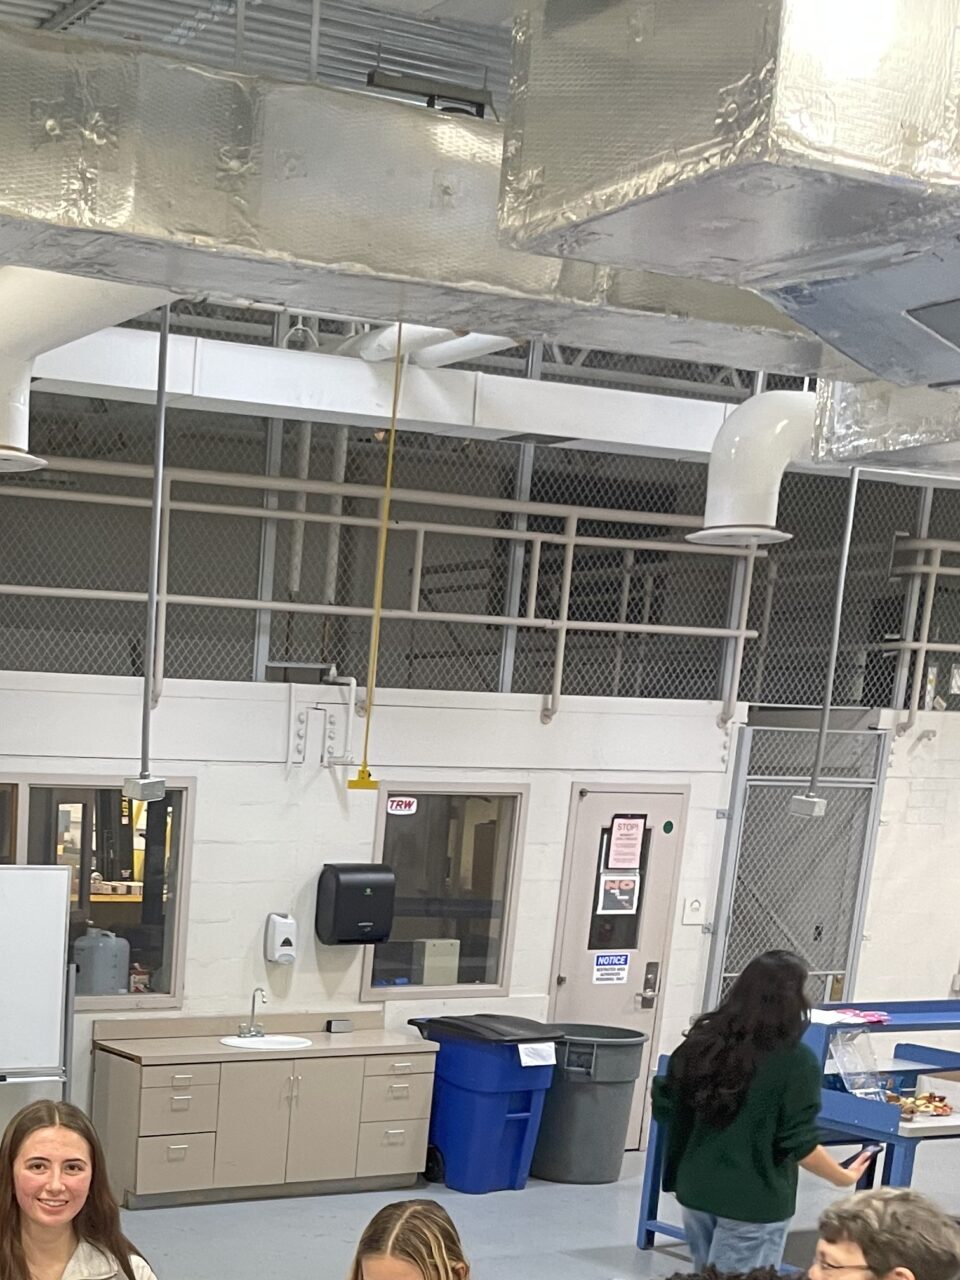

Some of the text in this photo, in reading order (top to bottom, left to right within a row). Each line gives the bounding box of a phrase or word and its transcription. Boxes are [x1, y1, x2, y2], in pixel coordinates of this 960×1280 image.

[390, 800, 415, 809] TRW
[617, 823, 639, 831] STOP!
[598, 956, 627, 965] NOTICE
